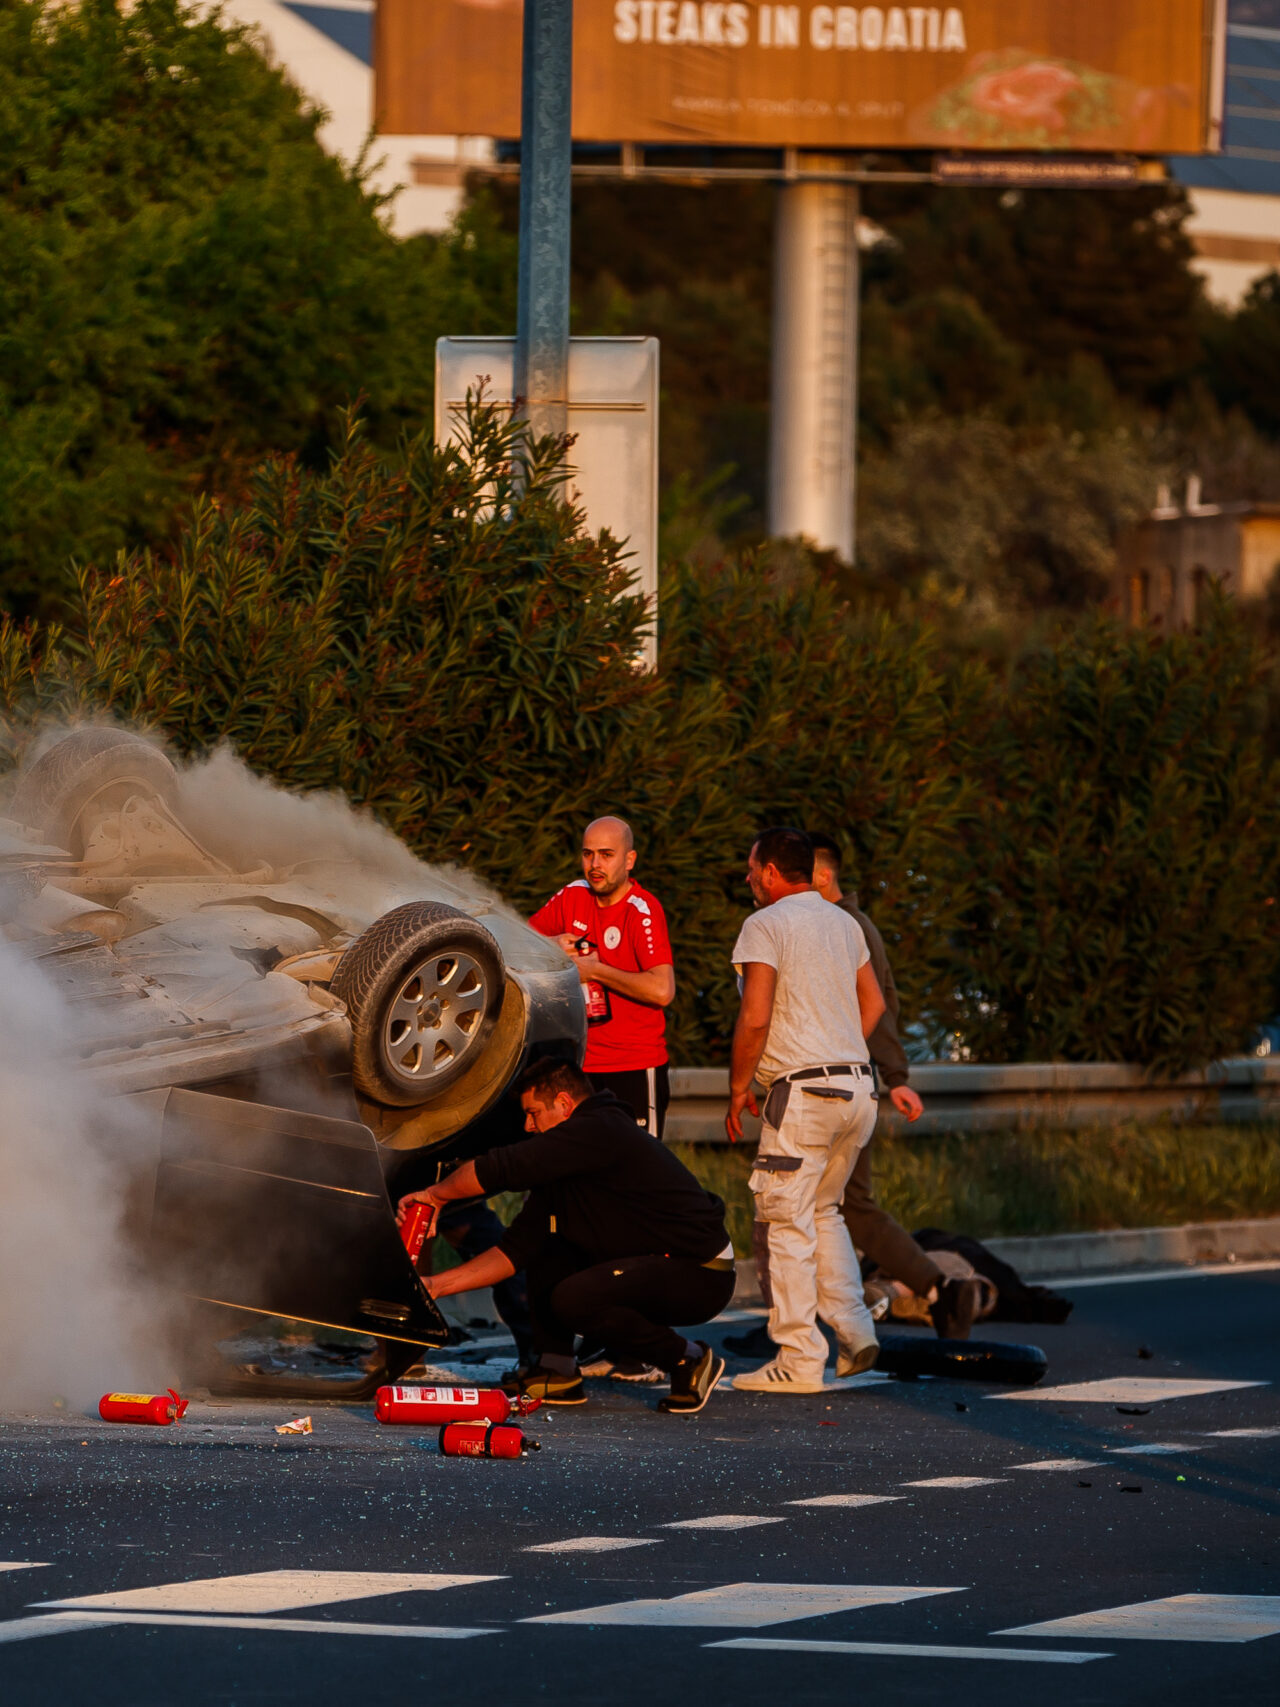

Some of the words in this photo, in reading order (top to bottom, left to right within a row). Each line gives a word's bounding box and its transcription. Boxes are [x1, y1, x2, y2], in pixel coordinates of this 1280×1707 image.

[614, 0, 749, 47] STEAKS
[758, 5, 801, 48] IN
[809, 6, 967, 51] CROATIA
